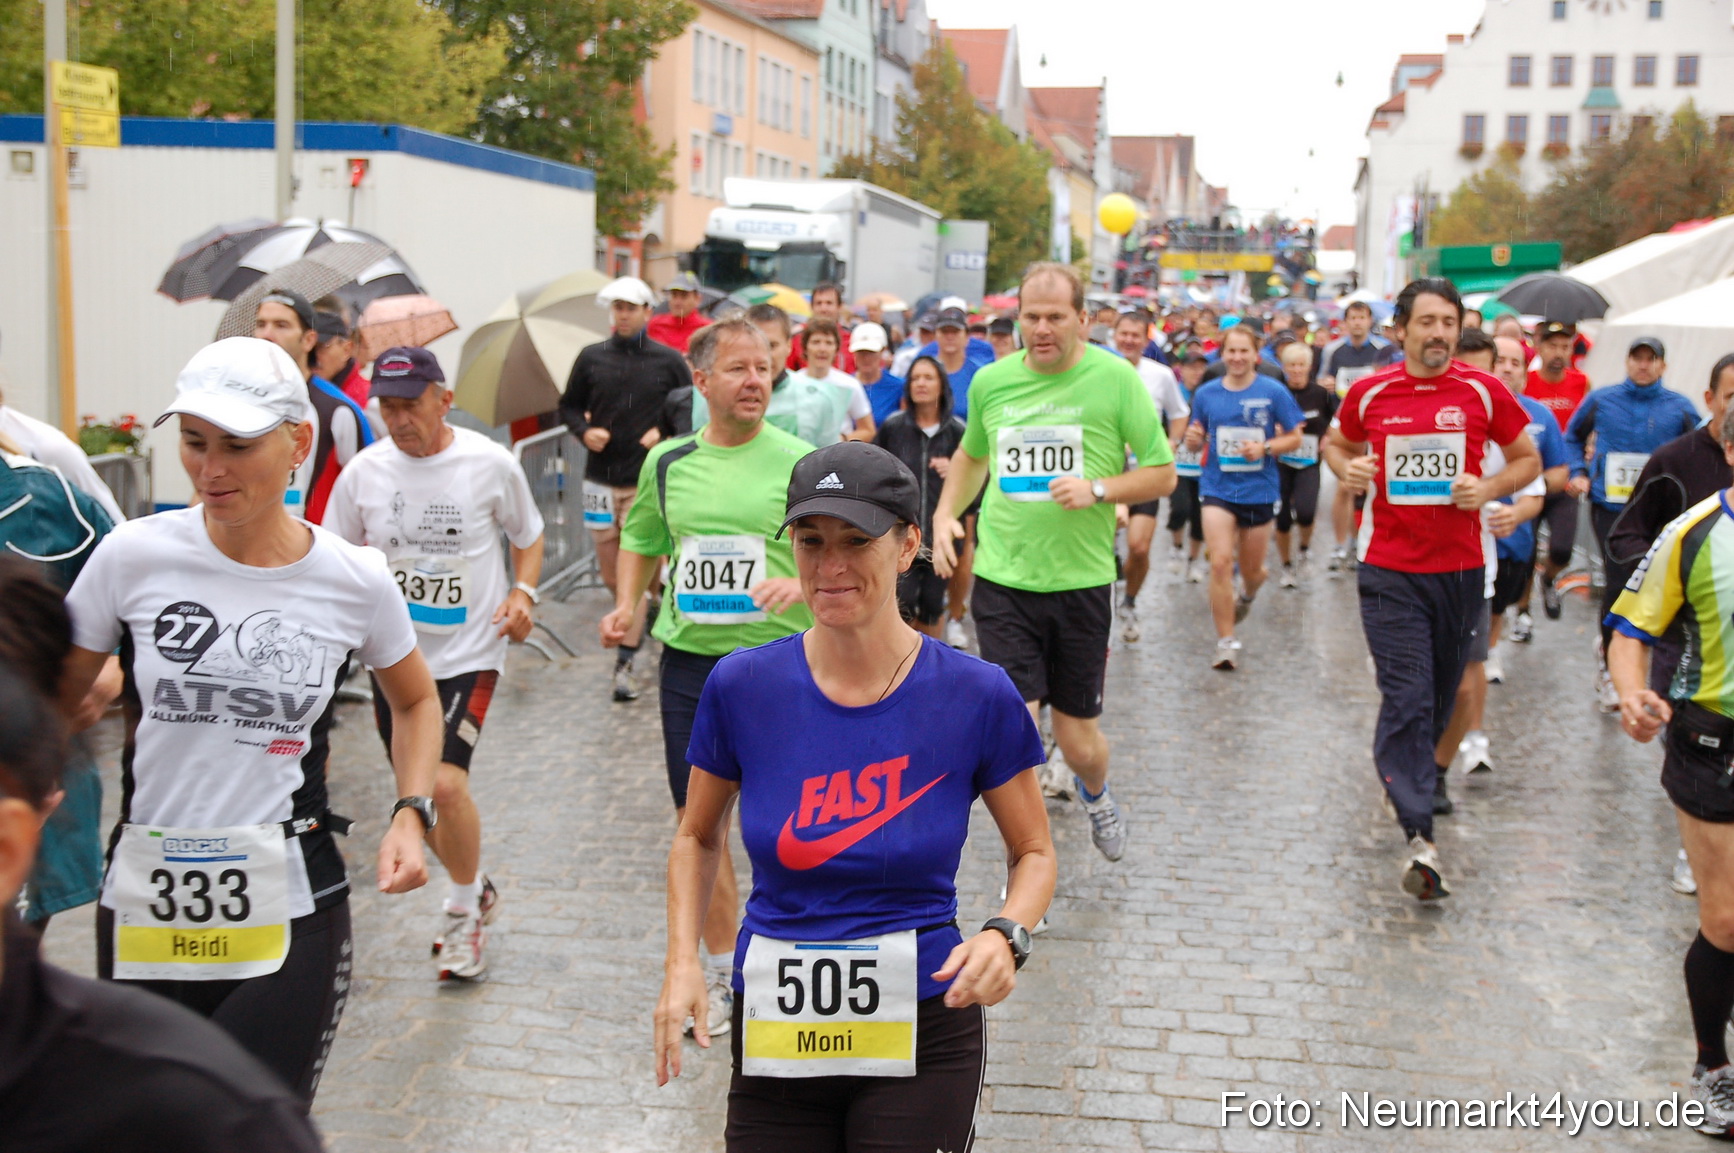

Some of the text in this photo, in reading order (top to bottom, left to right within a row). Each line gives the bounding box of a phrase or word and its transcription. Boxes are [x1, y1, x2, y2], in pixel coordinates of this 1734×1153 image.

[1007, 446, 1074, 473] 3100
[1395, 453, 1458, 477] 2339
[394, 570, 463, 604] 3375
[684, 559, 756, 590] 3047
[177, 604, 200, 615] 2011
[692, 597, 745, 610] Christian
[156, 612, 215, 651] 27
[152, 677, 320, 722] ATSV
[149, 709, 220, 724] ALLMÜNZ
[796, 754, 911, 829] FAST
[162, 838, 229, 853] BOCK
[149, 868, 251, 923] 333
[172, 935, 229, 957] Heidi
[777, 958, 880, 1016] 505
[797, 1029, 852, 1053] Moni
